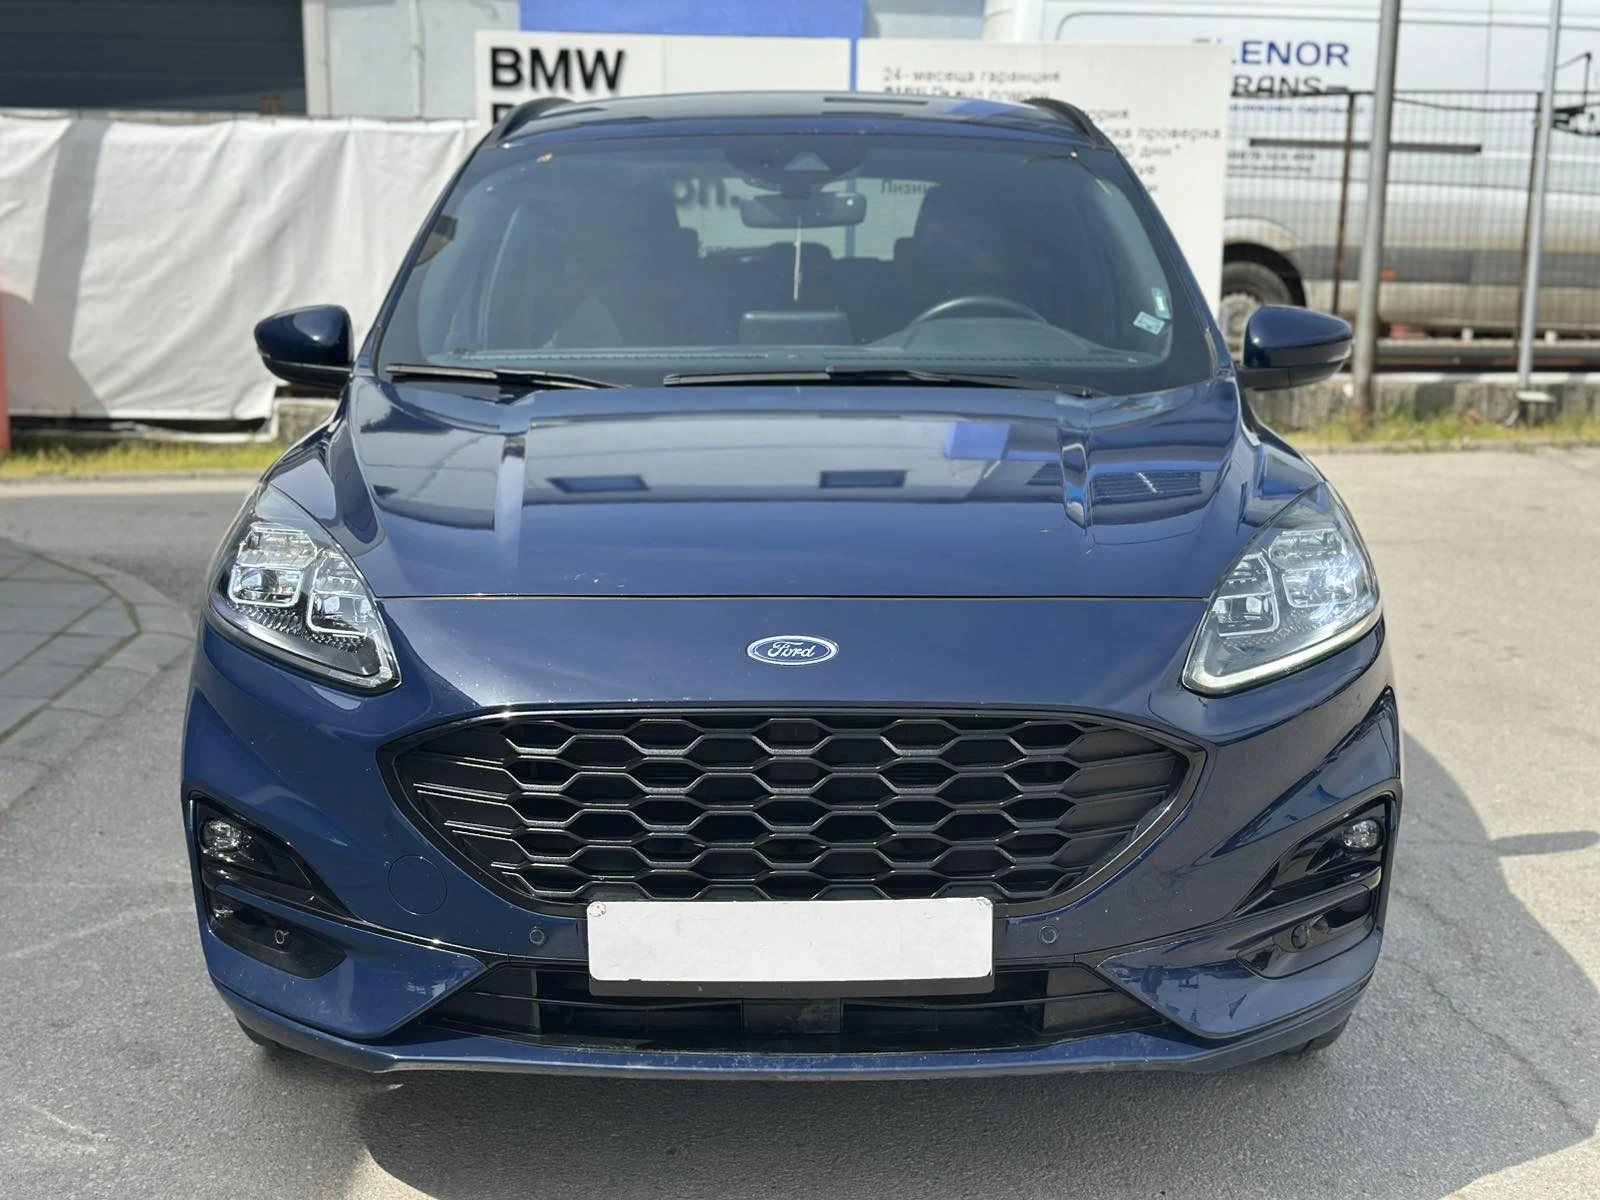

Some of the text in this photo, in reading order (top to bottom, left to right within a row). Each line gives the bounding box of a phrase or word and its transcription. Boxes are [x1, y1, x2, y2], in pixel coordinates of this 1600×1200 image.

[1193, 40, 1350, 67] ENOR
[490, 47, 625, 91] BMW
[1232, 75, 1323, 97] RANS
[767, 641, 816, 658] Ford
